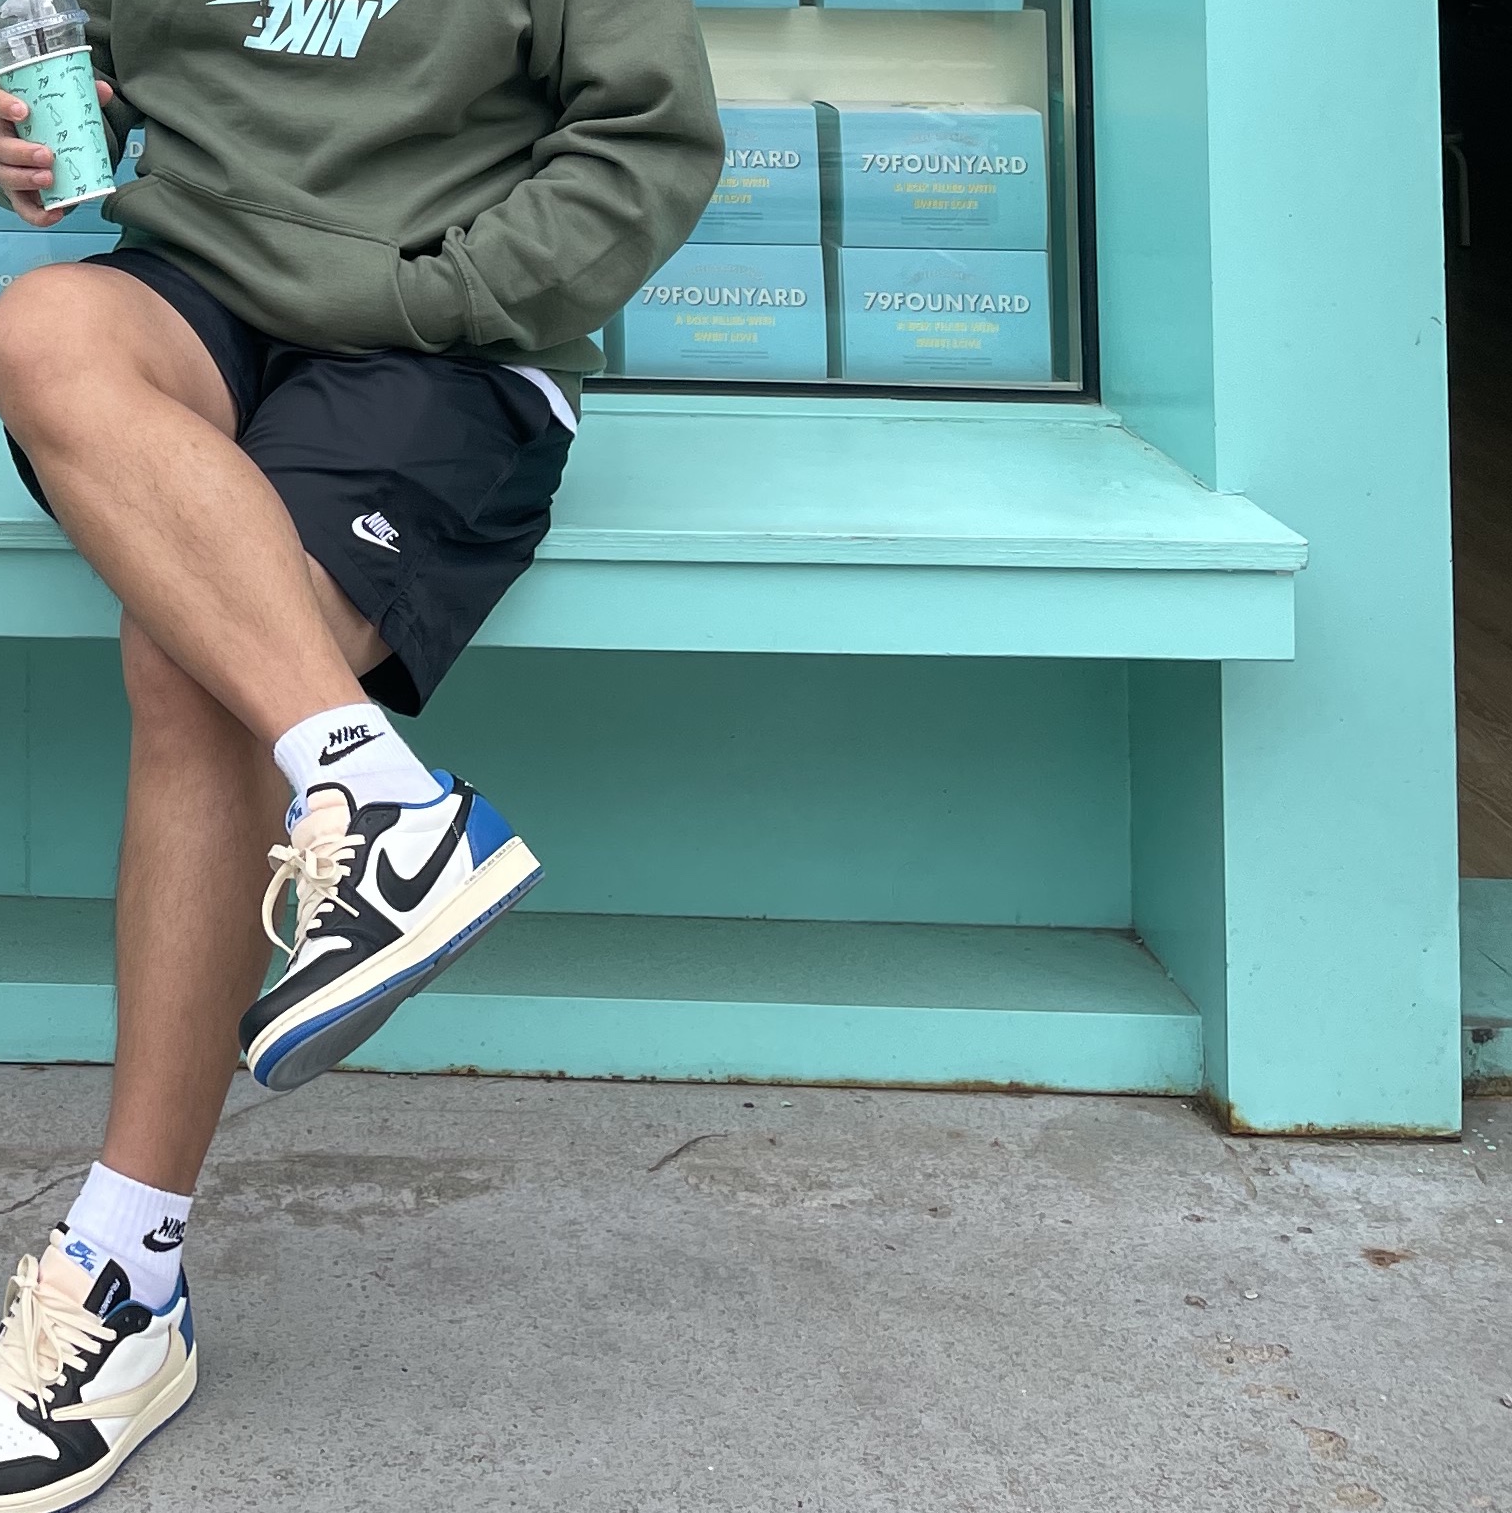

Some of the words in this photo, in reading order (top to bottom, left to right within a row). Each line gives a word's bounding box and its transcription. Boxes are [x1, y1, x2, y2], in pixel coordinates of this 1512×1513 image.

[725, 149, 801, 169] NYARD
[860, 153, 1028, 174] 79FOUNYARD
[642, 286, 807, 307] 79FOUNYARD
[863, 291, 1030, 313] 79FOUNYARD
[328, 724, 370, 747] NIKE
